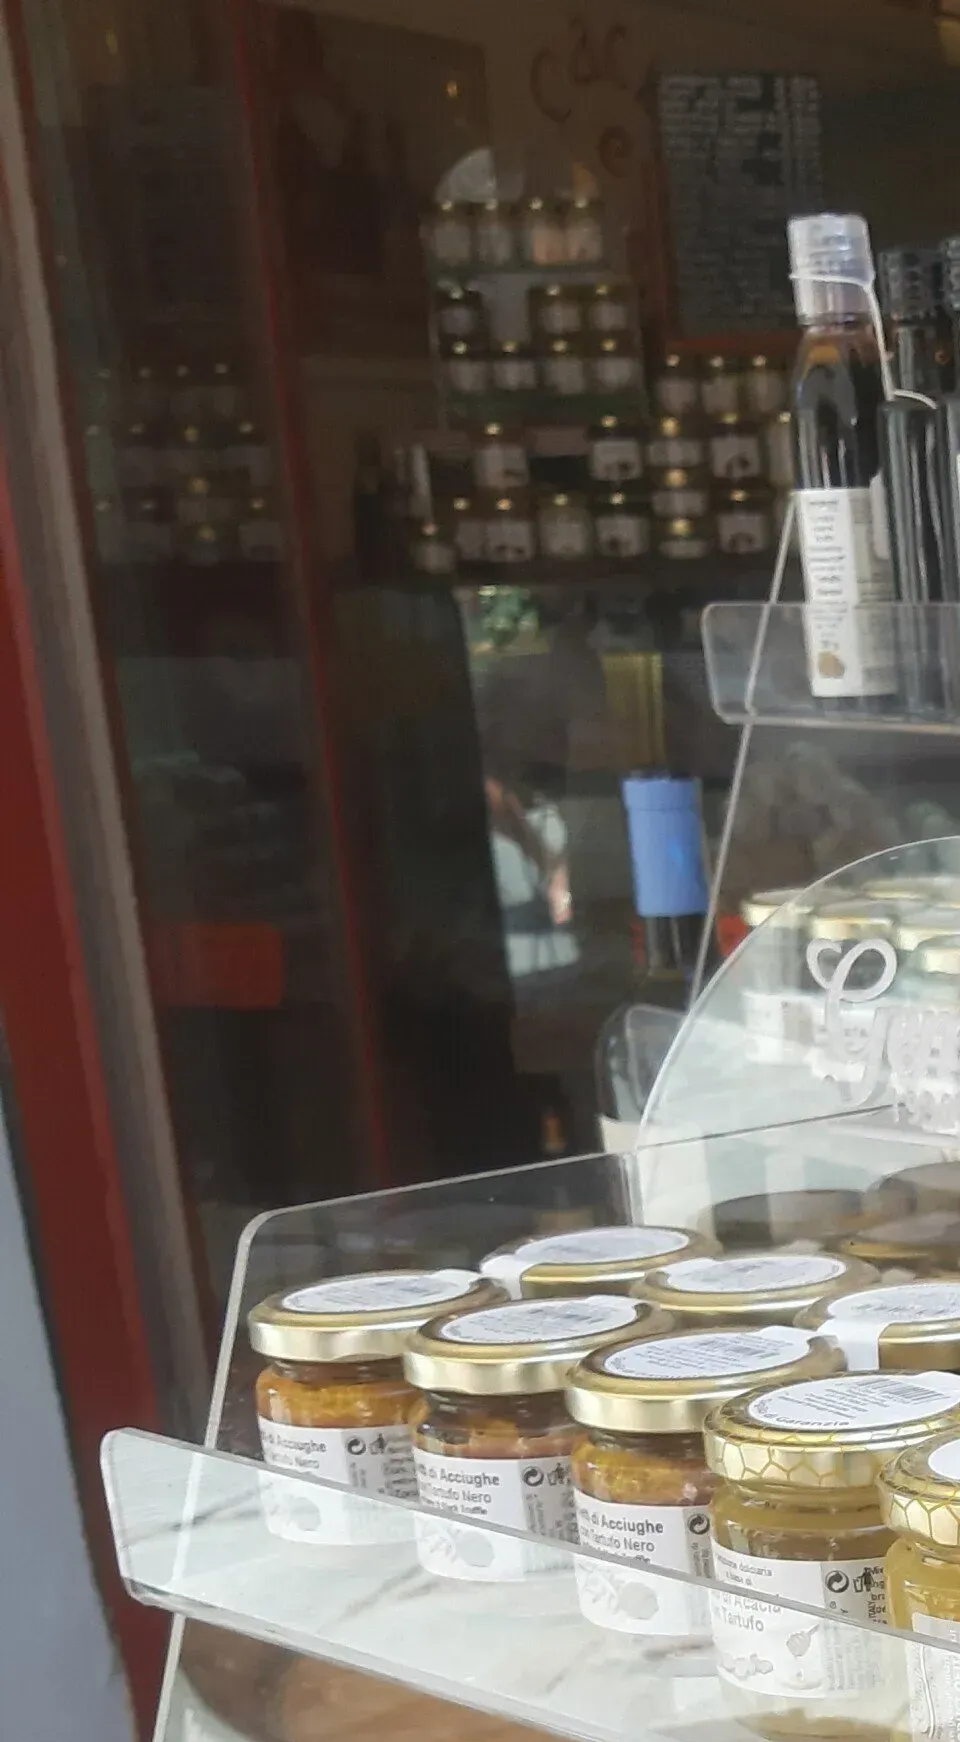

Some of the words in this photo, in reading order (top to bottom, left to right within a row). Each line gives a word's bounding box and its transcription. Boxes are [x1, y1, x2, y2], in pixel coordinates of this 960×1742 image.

[439, 1469, 501, 1488] Acciughe
[461, 1489, 493, 1504] Nero
[601, 1517, 665, 1535] Acciughe
[623, 1536, 656, 1554] Nero
